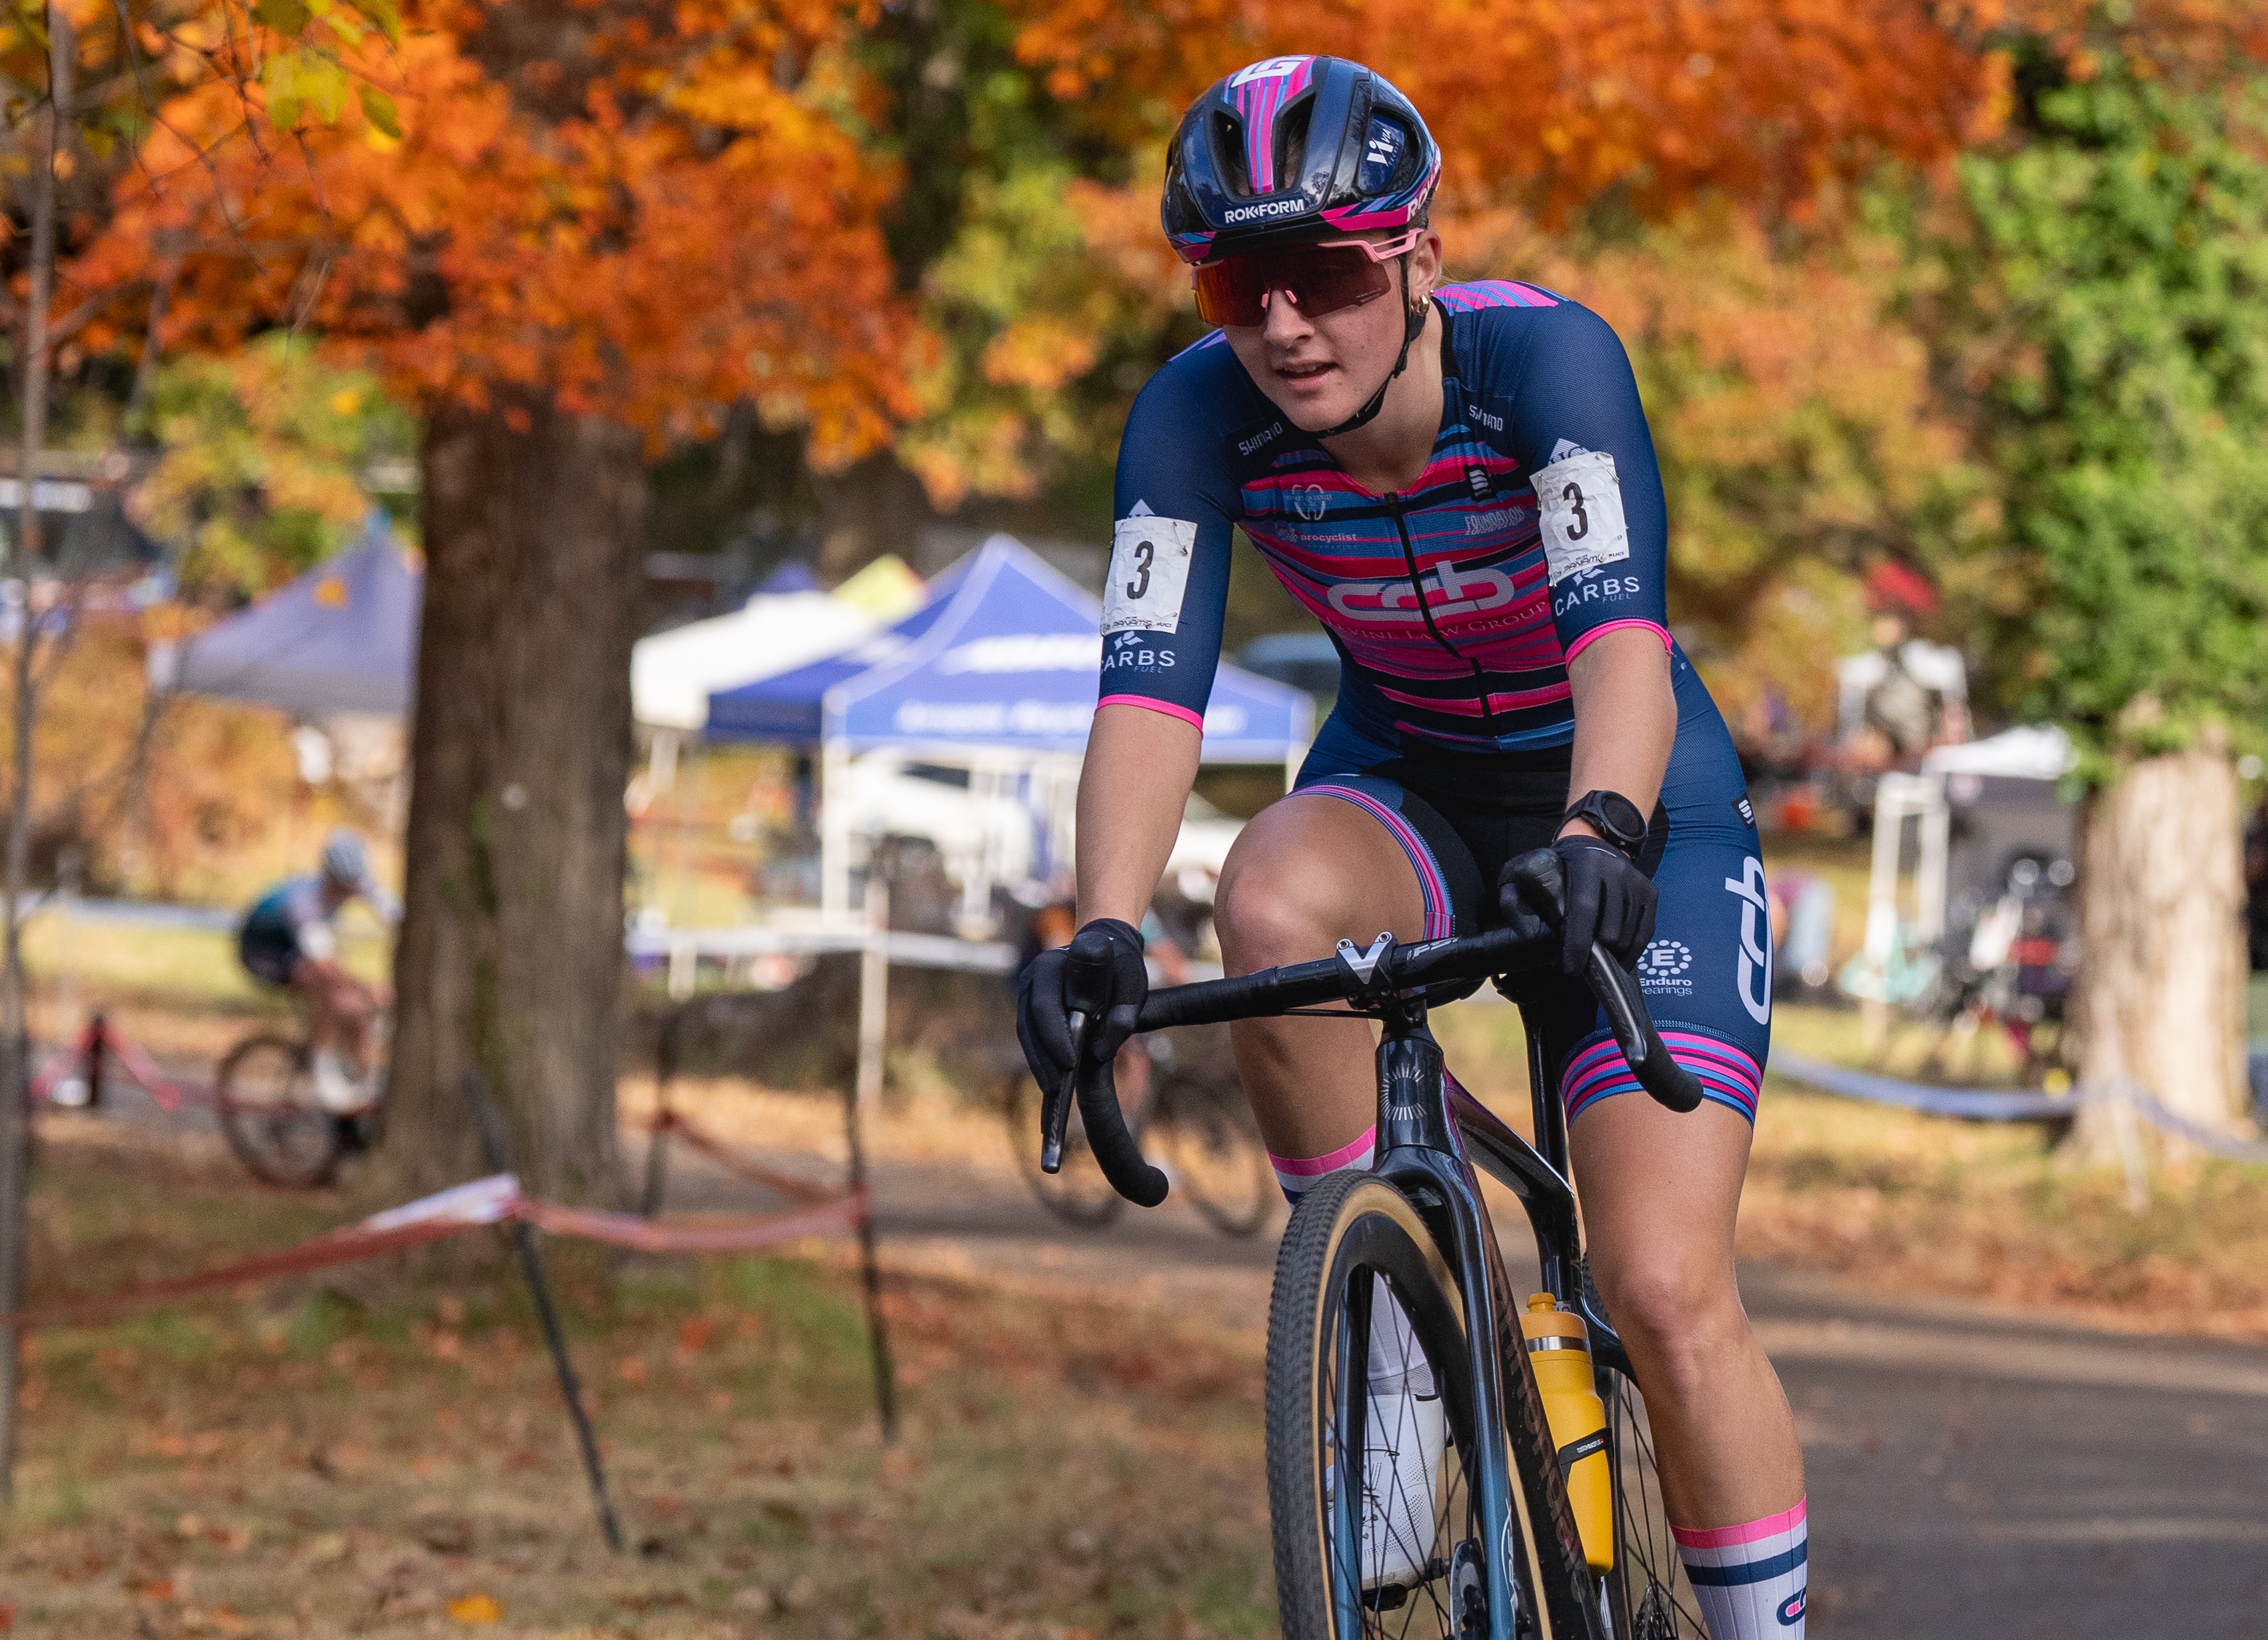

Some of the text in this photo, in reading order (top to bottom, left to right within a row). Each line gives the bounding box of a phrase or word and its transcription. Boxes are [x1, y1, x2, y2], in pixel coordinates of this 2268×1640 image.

[1563, 482, 1588, 541] 3
[1126, 541, 1154, 600] 3
[1555, 577, 1640, 617] CARBS
[1102, 650, 1176, 671] ARBS
[1640, 977, 1692, 987] Enduro
[1642, 987, 1693, 997] earings
